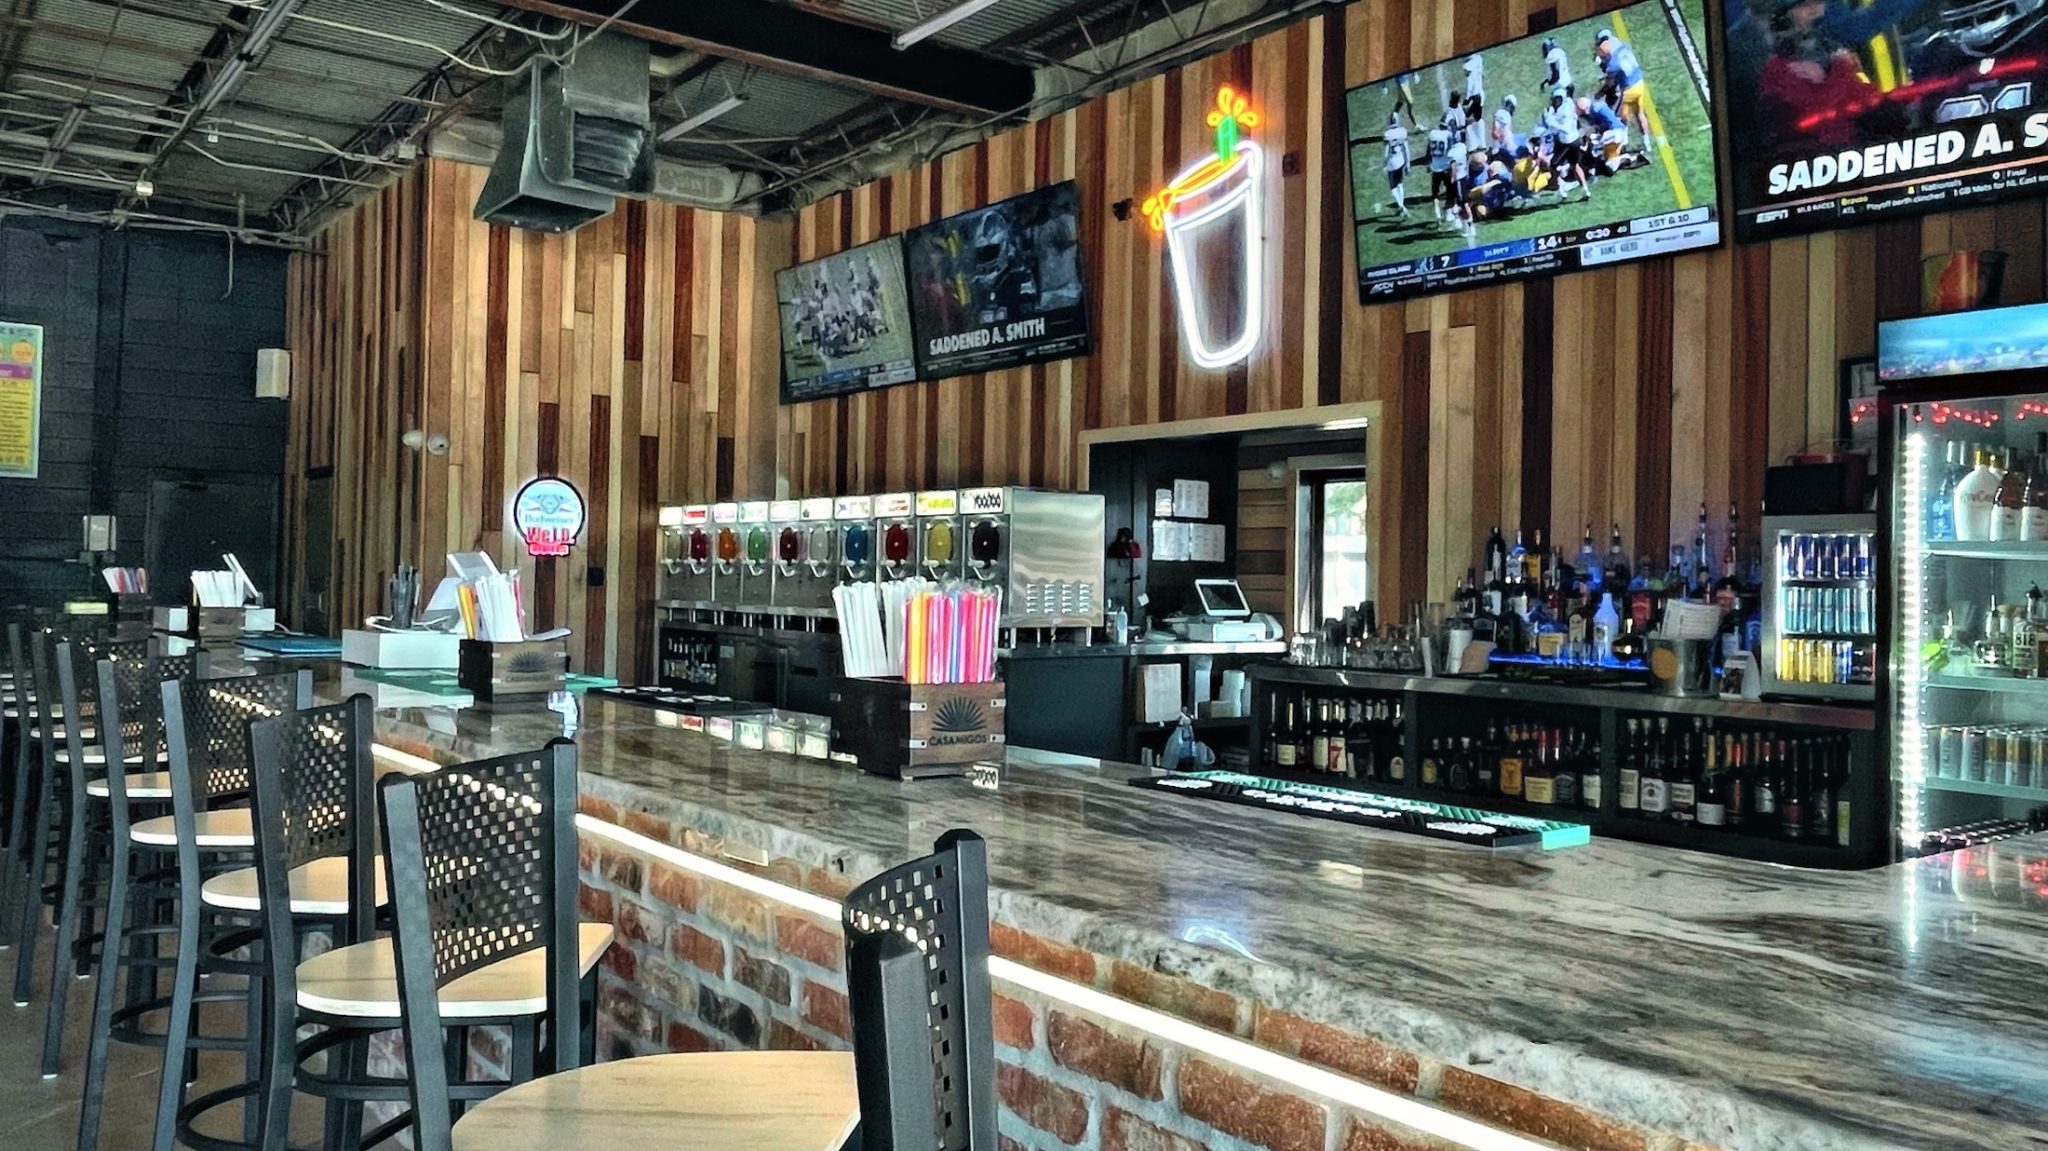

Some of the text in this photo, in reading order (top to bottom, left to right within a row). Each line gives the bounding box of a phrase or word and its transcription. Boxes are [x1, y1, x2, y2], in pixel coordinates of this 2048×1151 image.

[1768, 130, 1966, 195] SADDENED
[1971, 122, 2014, 158] A.
[1648, 218, 1665, 228] 1ST
[1677, 213, 1690, 223] 10
[1756, 209, 1789, 223] ESPN
[1440, 255, 1450, 267] 7
[929, 317, 1046, 356] SADDENED A. SMITH
[2015, 633, 2037, 647] 818
[928, 734, 988, 746] CASAMIGOS
